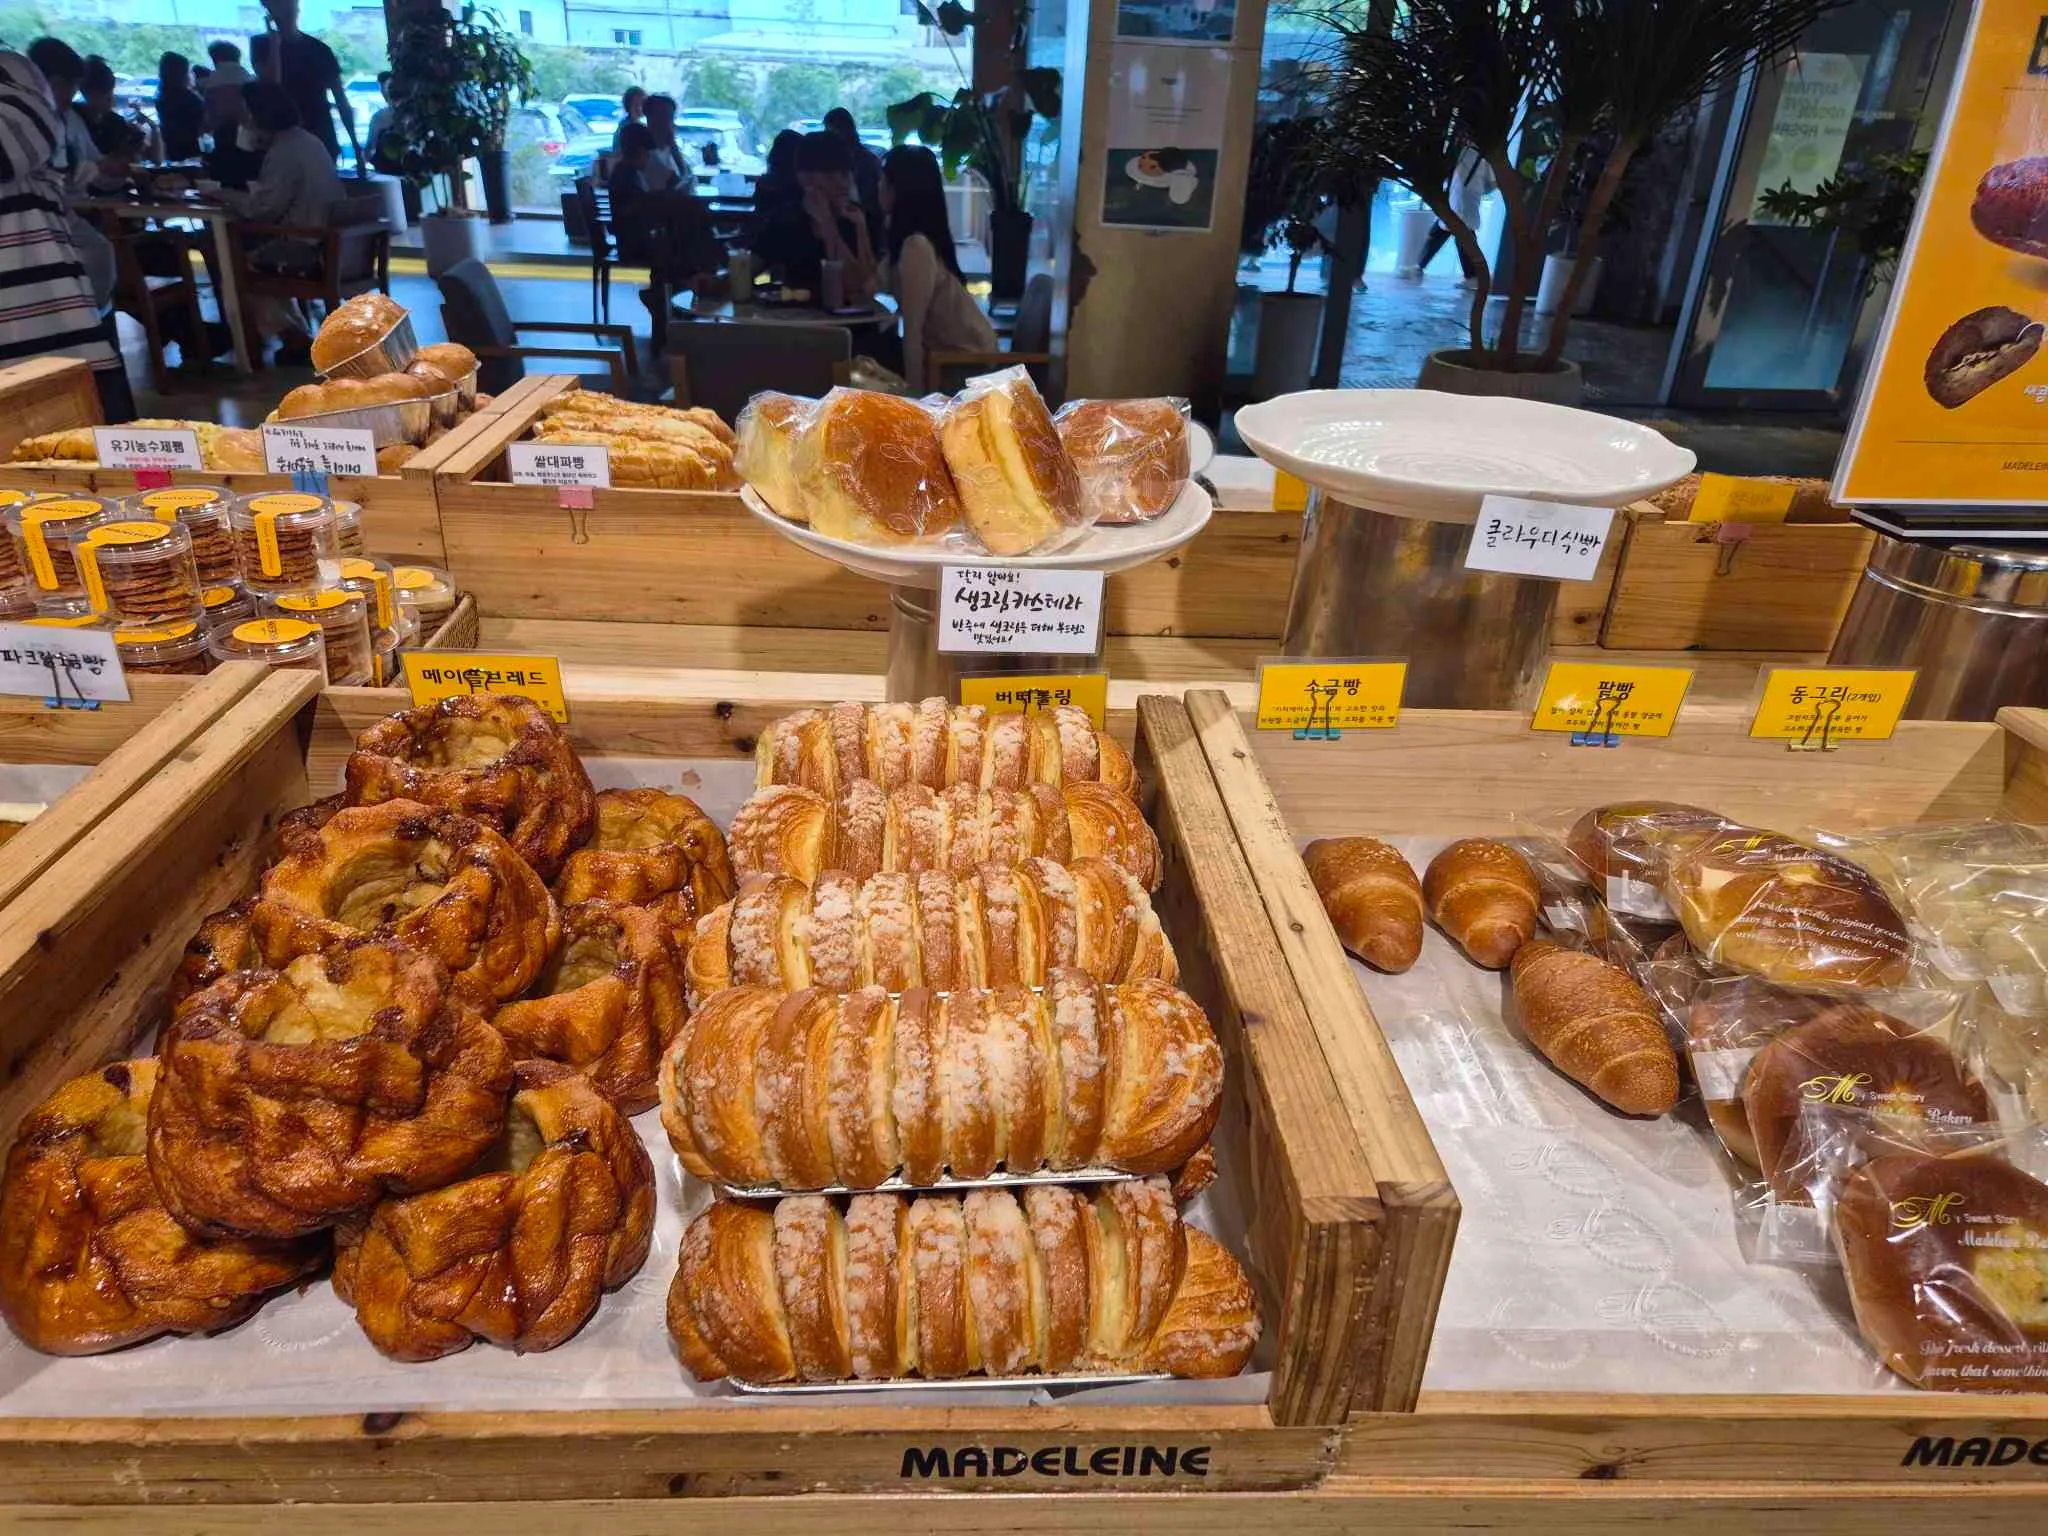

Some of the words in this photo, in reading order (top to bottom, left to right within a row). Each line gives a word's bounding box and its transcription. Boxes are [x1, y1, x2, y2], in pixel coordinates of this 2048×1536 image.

[1487, 519, 1601, 556] 클라우디식빵
[955, 587, 1083, 613] 생크림카스테라
[952, 619, 986, 633] 반죽에
[990, 620, 1027, 634] 생크림을
[1304, 679, 1361, 696] 소금빵
[1597, 681, 1635, 701] 팥빵
[1790, 686, 1848, 704] 동그리
[900, 1447, 1212, 1478] MADELEINE
